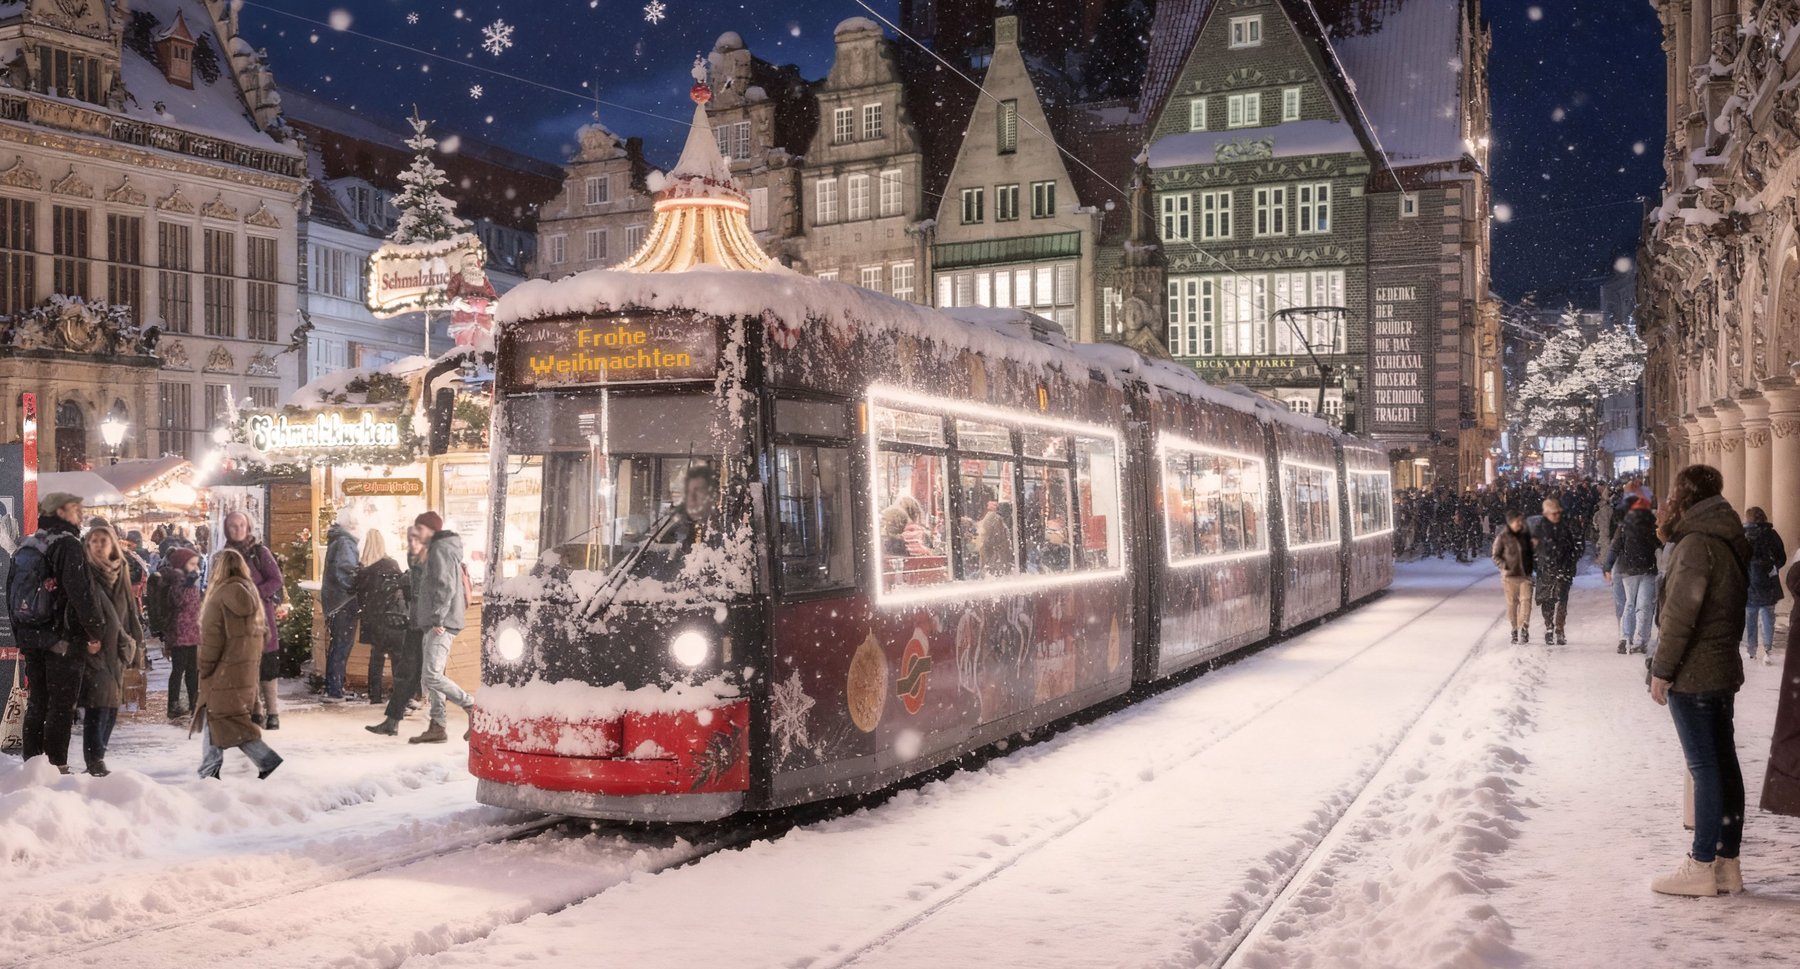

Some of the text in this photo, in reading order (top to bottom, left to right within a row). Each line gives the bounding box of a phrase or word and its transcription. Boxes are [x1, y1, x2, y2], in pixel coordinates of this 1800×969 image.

[1376, 287, 1417, 301] GEDENKE
[1375, 304, 1394, 319] DER
[1375, 319, 1417, 335] BRÜDER,
[578, 326, 647, 348] Frohe
[1375, 338, 1411, 352] DIE DAS
[530, 347, 690, 375] Weihnachten
[1234, 360, 1250, 368] AM
[1256, 359, 1295, 368] MARKT
[1375, 355, 1424, 369] SCHICKSAL
[1375, 372, 1418, 387] UNSERER
[1375, 389, 1425, 404] TRENNUNG
[251, 411, 399, 452] Schmalzkuchen
